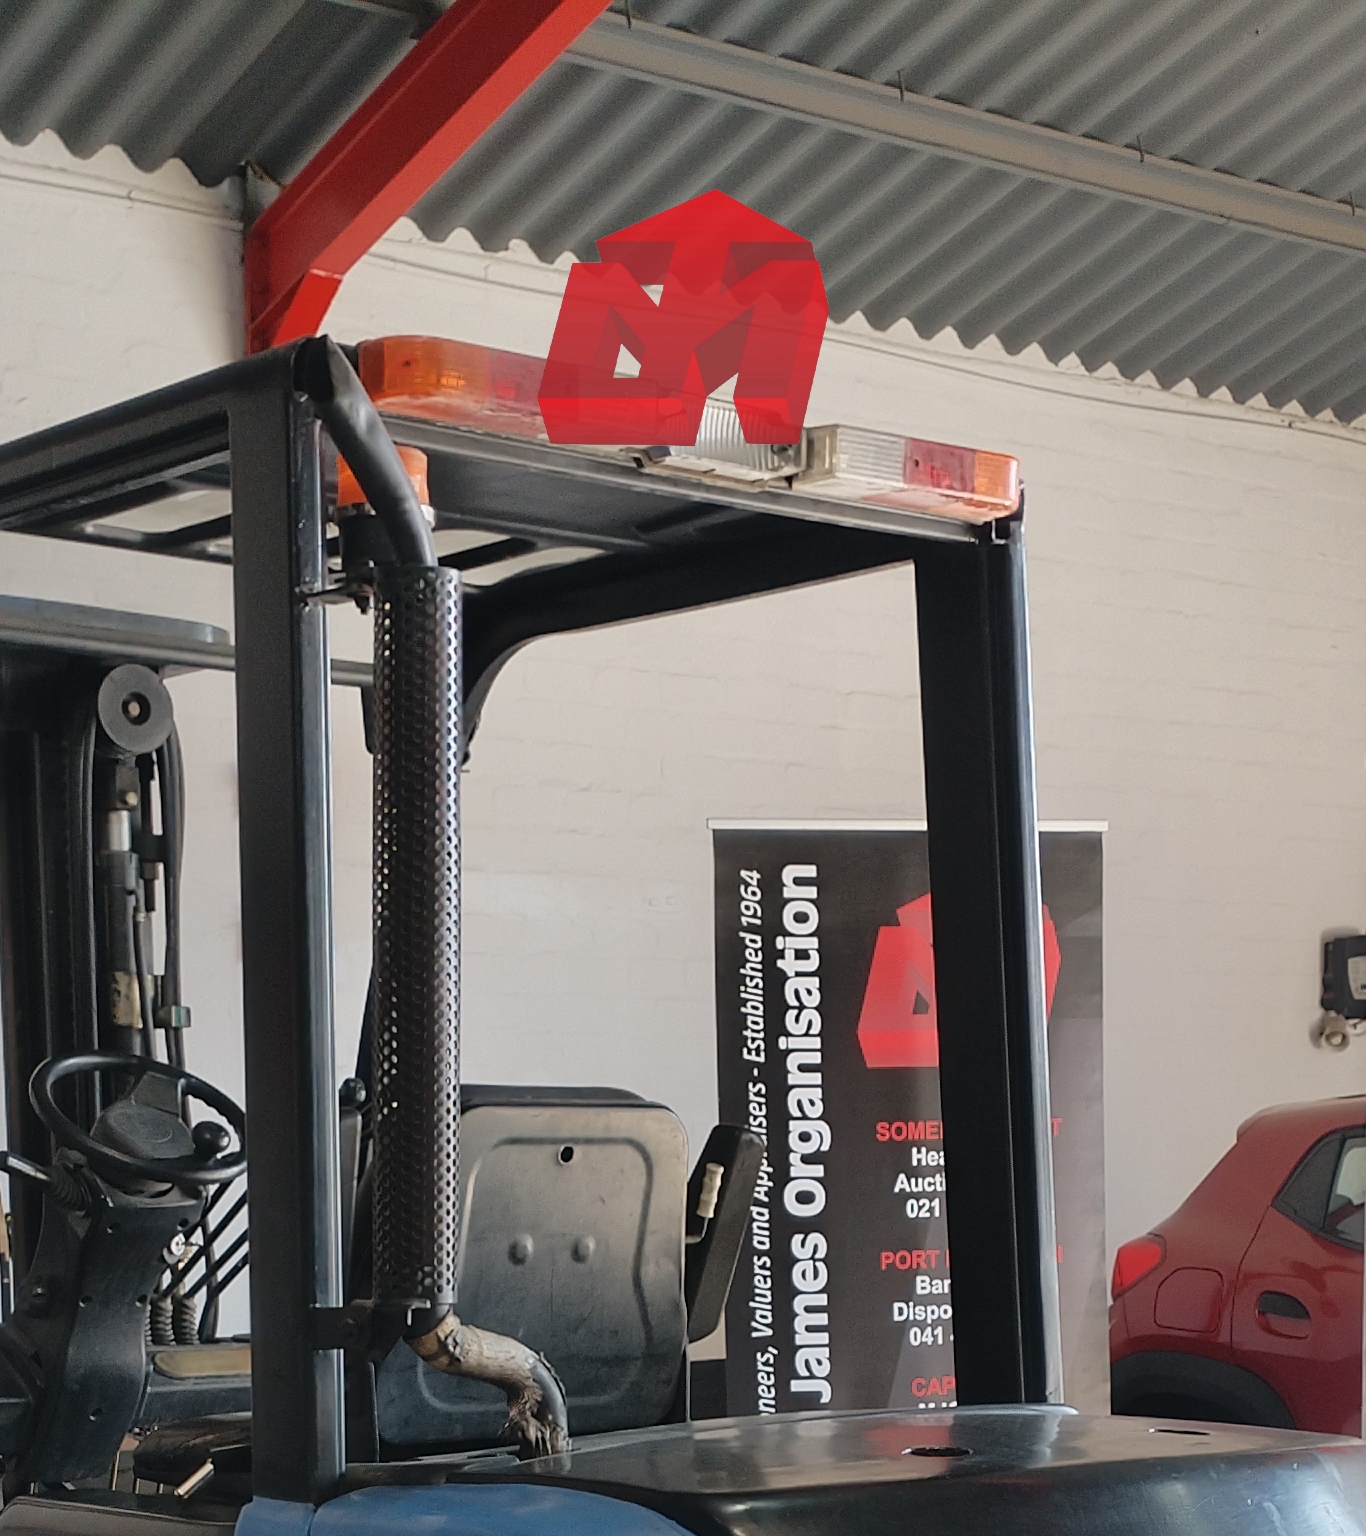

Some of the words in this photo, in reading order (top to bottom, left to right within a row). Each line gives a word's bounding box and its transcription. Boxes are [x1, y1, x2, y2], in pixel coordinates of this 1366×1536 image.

[739, 869, 762, 926] 1964
[738, 931, 766, 1063] Established
[775, 864, 832, 1218] Organisation
[875, 1120, 944, 1142] SOME
[893, 1171, 946, 1193] Aucti
[906, 1197, 941, 1219] 021
[750, 1206, 771, 1250] and
[880, 1250, 940, 1270] PORT
[749, 1255, 774, 1338] Valuers
[893, 1301, 954, 1324] Dispo
[790, 1231, 832, 1403] James
[909, 1326, 944, 1347] 041
[757, 1346, 779, 1417] neers,
[911, 1376, 956, 1397] CAP
